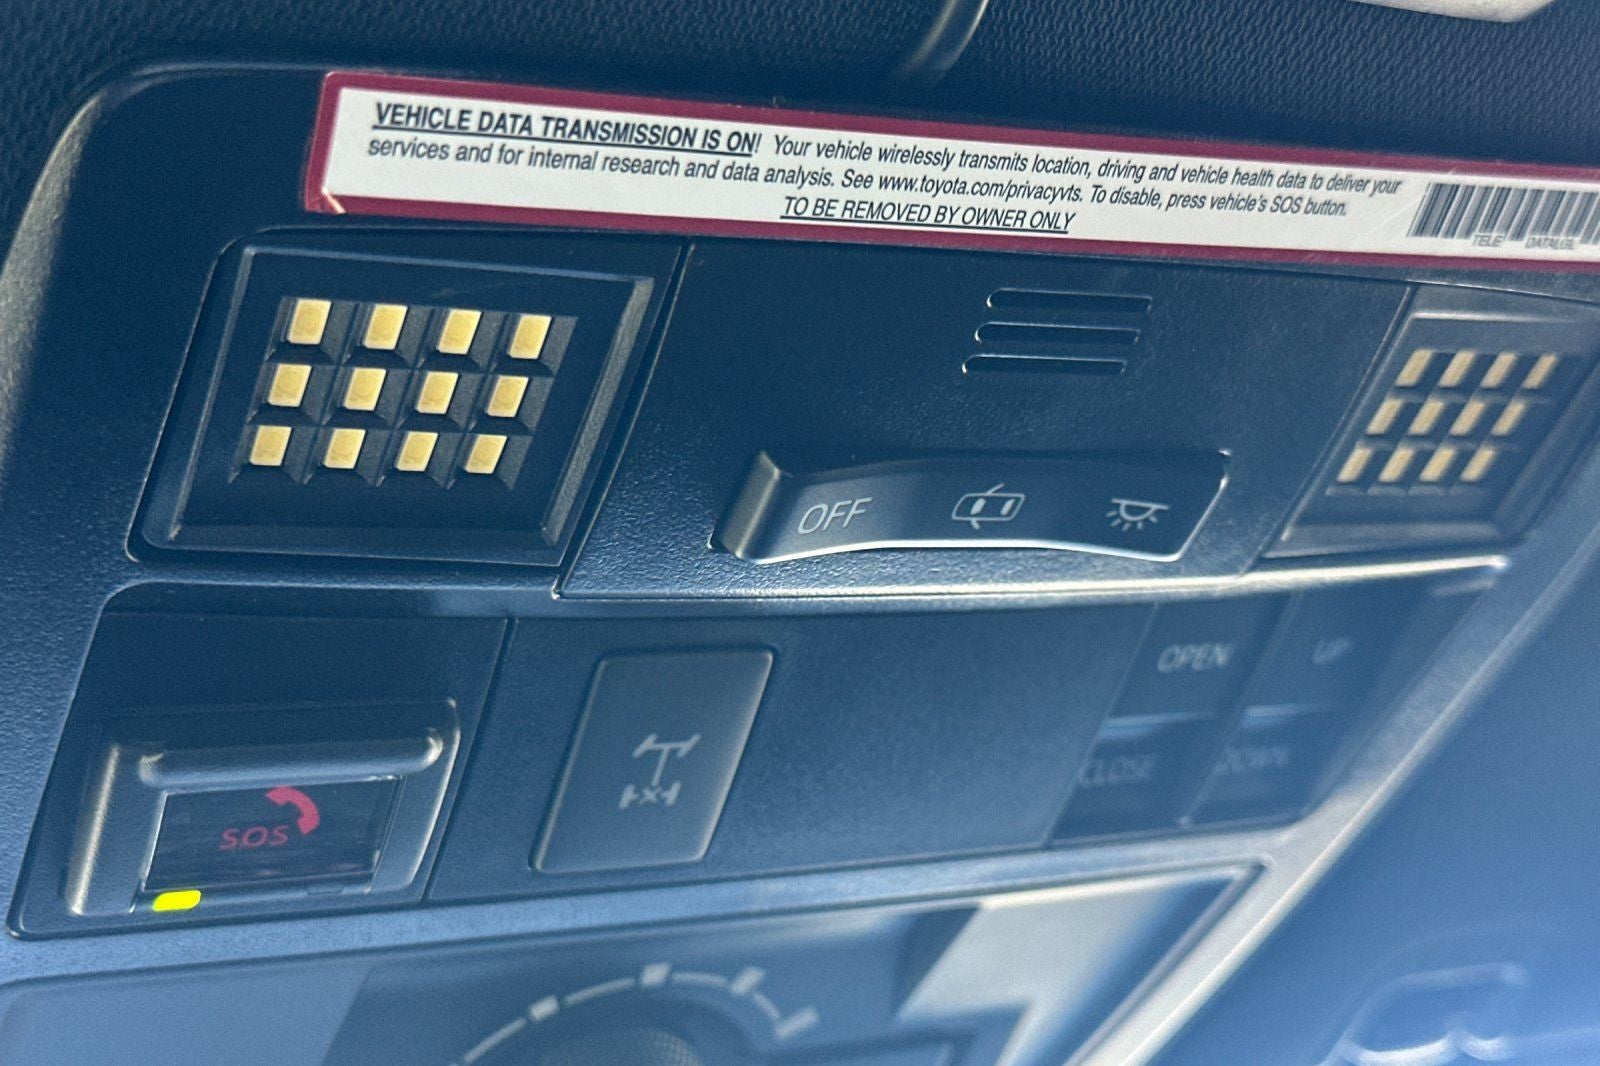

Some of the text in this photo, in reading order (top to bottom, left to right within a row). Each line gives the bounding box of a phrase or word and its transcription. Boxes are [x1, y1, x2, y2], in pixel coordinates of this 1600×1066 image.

[375, 102, 1402, 197] VEHICLE DATA TRANSMISSION IS ON! Your vehicle wirelessly transmits location, driving and vehicle health data to deliver your
[368, 137, 1347, 216] services and for internal research and data analysis. See www.toyota.com/privacyvts. To disable, press vehicle's SOS button.
[784, 196, 1076, 231] TO BE REMOVED BY OWNER ONLY
[797, 497, 873, 535] OFF
[1157, 643, 1232, 673] OPEN
[219, 825, 289, 850] SOS
